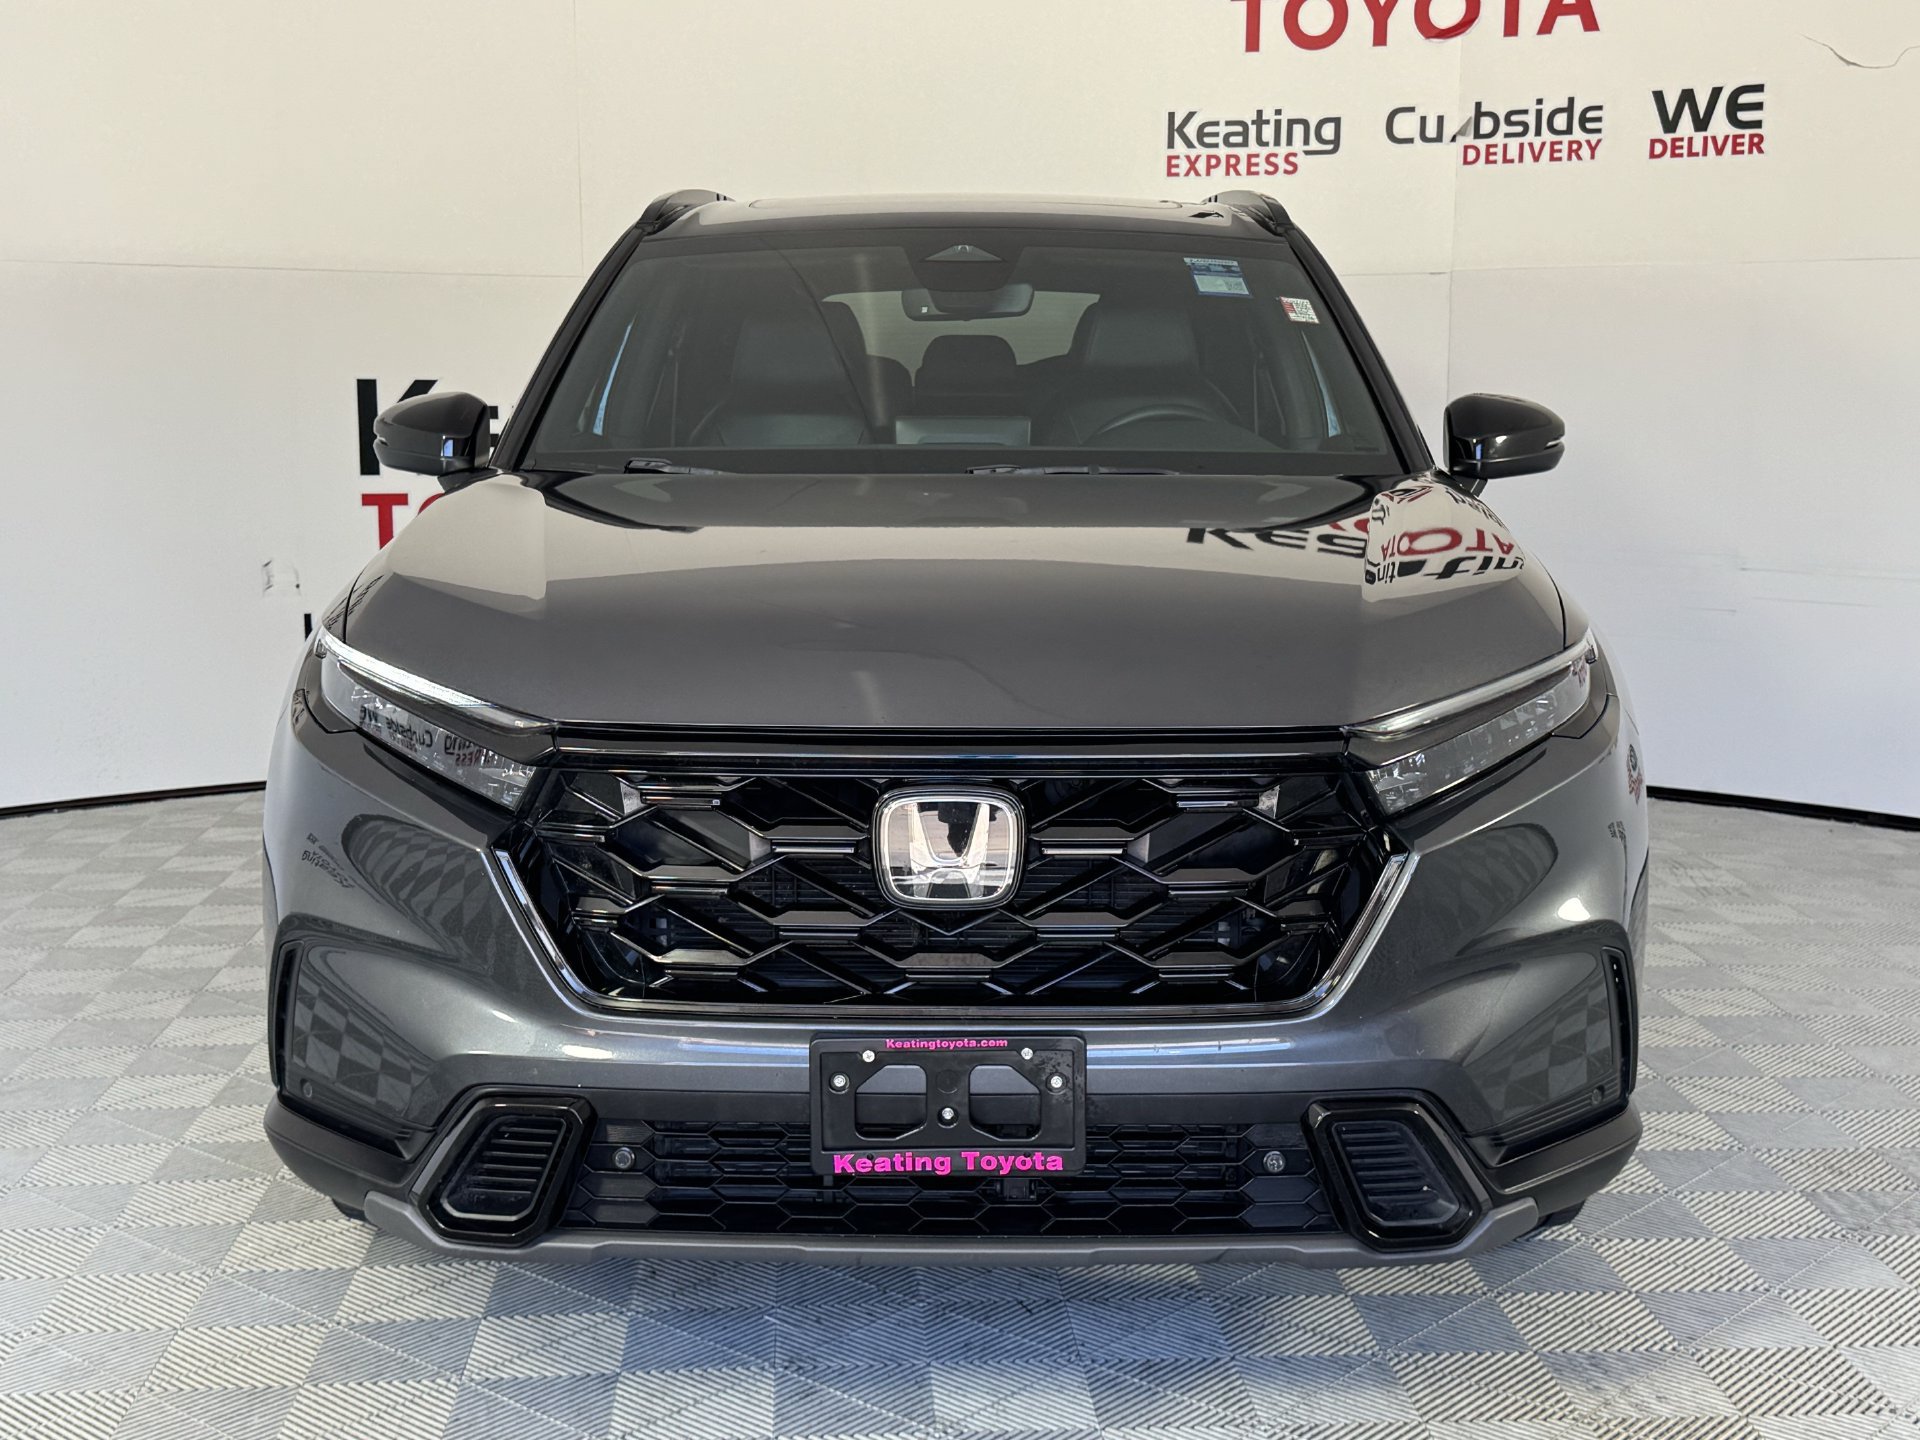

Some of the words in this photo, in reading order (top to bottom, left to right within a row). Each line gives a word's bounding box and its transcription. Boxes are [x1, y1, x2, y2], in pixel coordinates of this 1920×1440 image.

[1385, 96, 1604, 146] Cubside
[1651, 83, 1765, 136] WE
[1167, 109, 1342, 156] Keating
[1462, 139, 1603, 166] DELIVERY
[1649, 133, 1765, 160] DELIVER
[1166, 151, 1299, 178] EXPRESS
[886, 1038, 1008, 1050] Keatingtoyota.com
[833, 1152, 952, 1176] Keating
[960, 1150, 1064, 1176] Toyota
